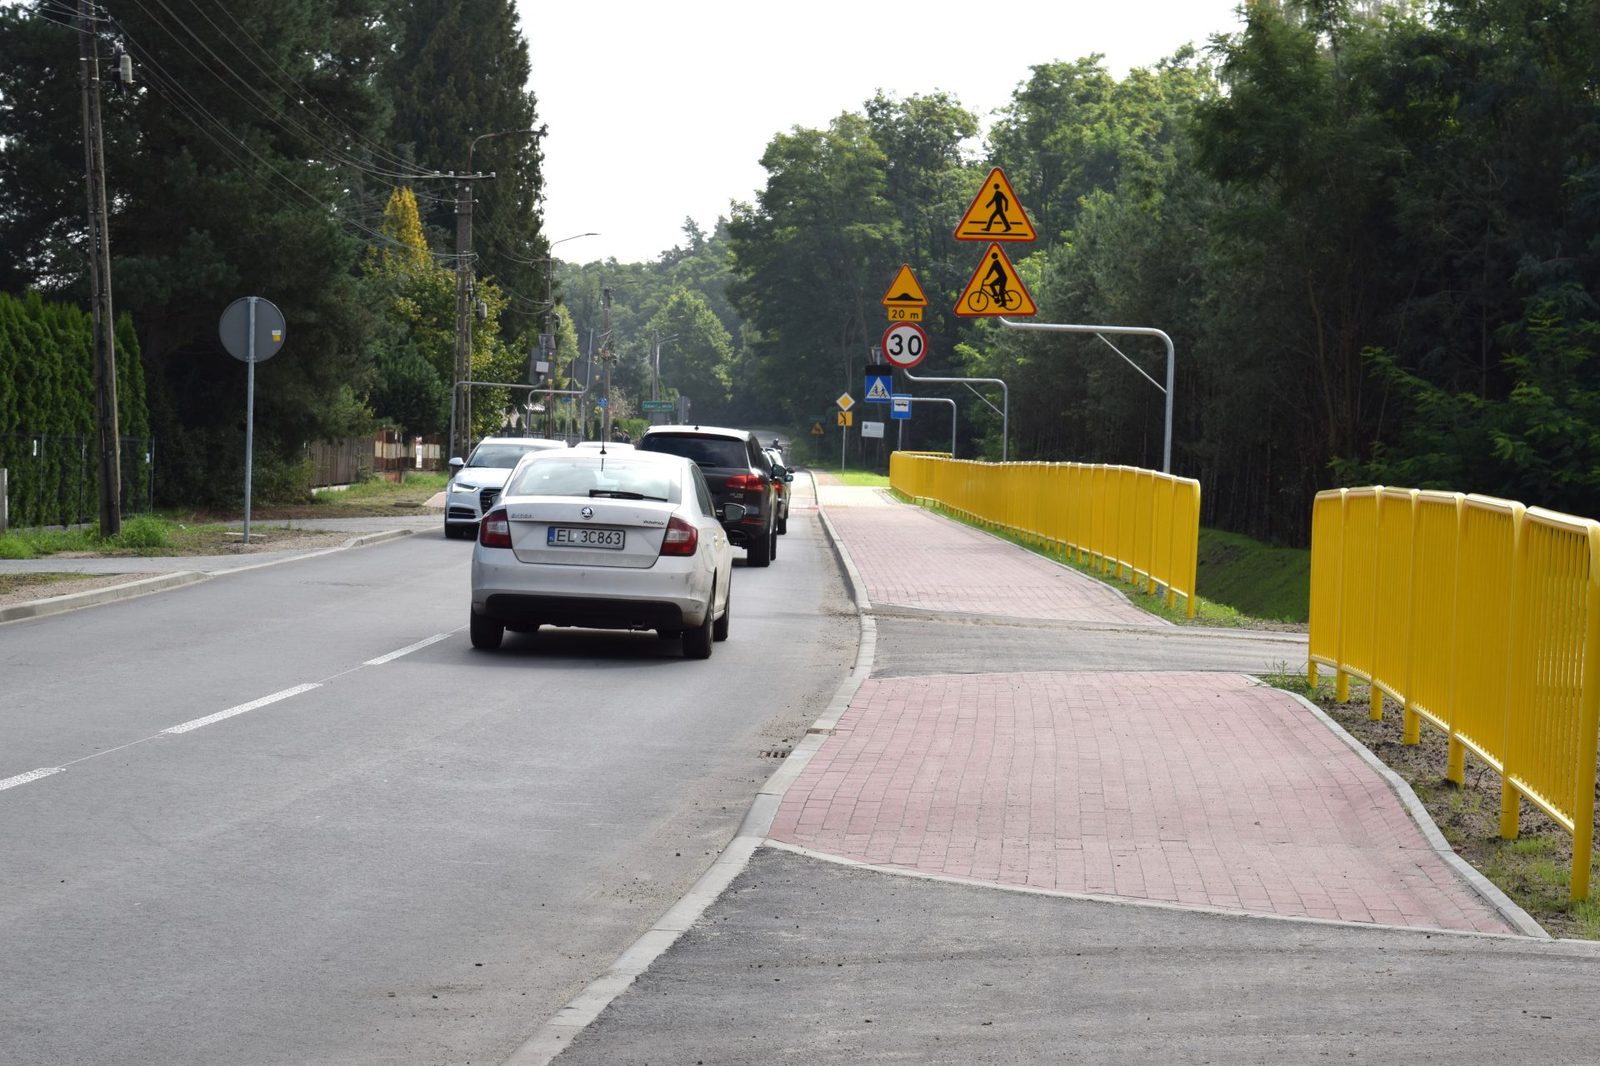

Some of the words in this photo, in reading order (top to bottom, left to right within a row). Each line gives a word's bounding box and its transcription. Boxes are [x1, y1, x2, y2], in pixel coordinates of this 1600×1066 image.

[892, 309, 905, 319] 20
[889, 333, 922, 356] 30
[556, 529, 575, 543] EL
[580, 530, 621, 545] 3C863
